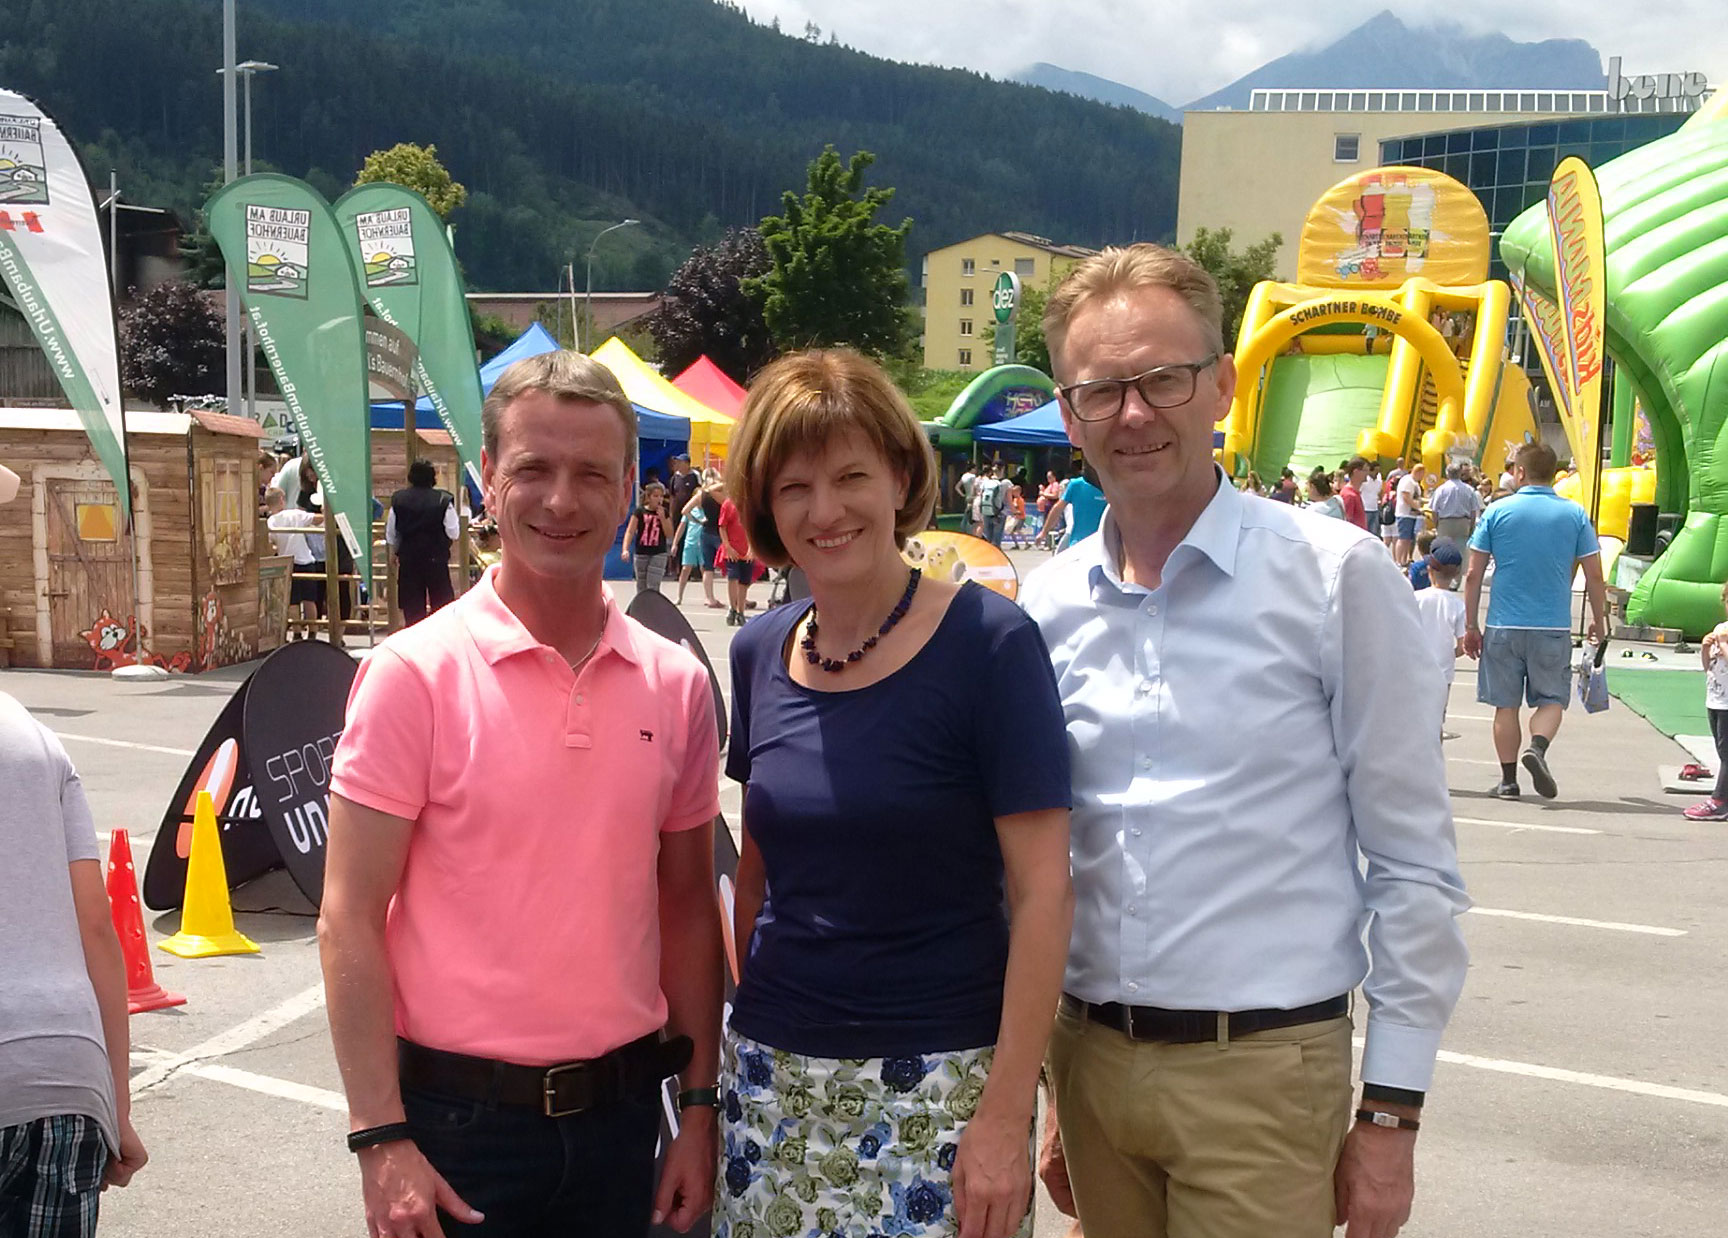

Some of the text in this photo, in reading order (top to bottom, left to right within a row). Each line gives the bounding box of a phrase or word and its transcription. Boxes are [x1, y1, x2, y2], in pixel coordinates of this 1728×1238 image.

[1607, 56, 1708, 100] bene
[993, 276, 1014, 310] dez
[1289, 301, 1402, 326] SCHARTNER BOMBE
